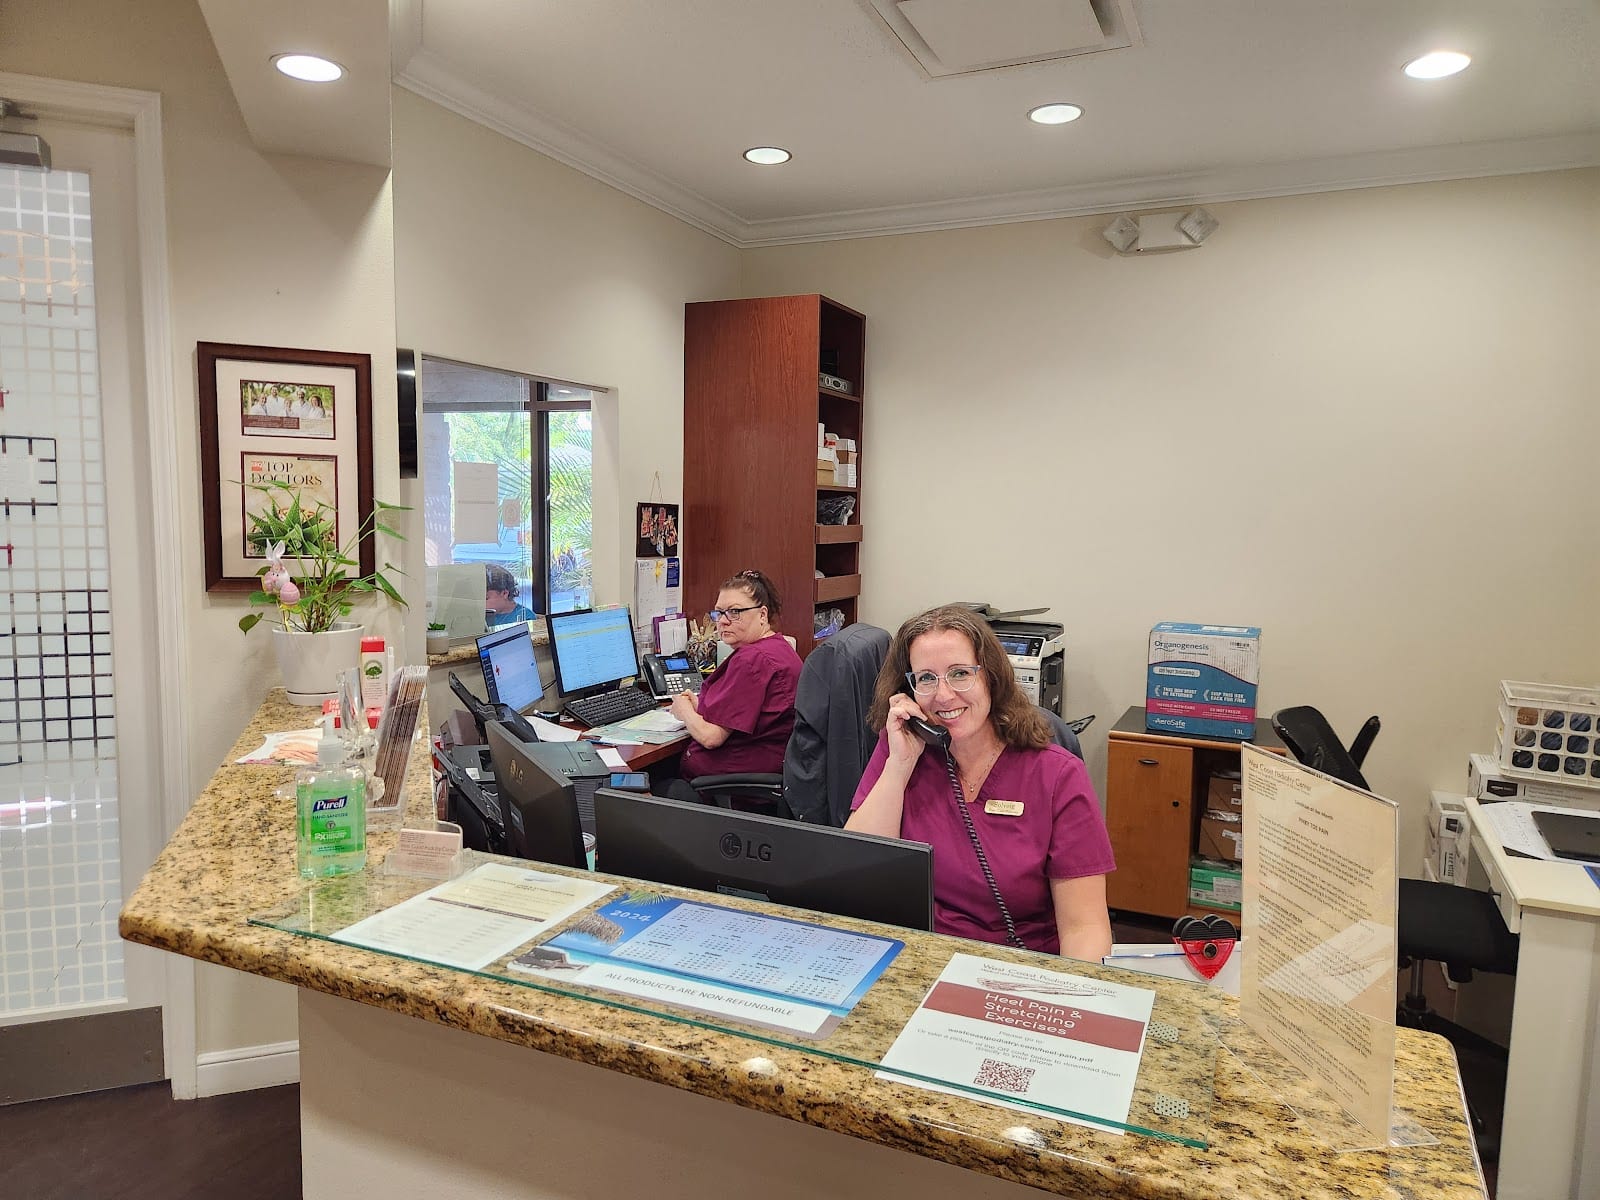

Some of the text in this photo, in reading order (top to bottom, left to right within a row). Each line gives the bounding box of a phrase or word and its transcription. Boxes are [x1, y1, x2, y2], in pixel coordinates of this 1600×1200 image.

[264, 462, 294, 472] TOP
[251, 473, 322, 486] DOCTORS
[1154, 640, 1209, 650] Organogenesis
[1155, 718, 1186, 726] AeroSafe
[317, 798, 345, 810] Purell
[746, 840, 772, 862] LG
[605, 972, 795, 1016] ALL PRODUCTS ARE NON-REFUNDABLE
[984, 993, 1082, 1020] Heel Pain &
[984, 1002, 1076, 1029] Stretching
[984, 1012, 1066, 1035] Exercises
